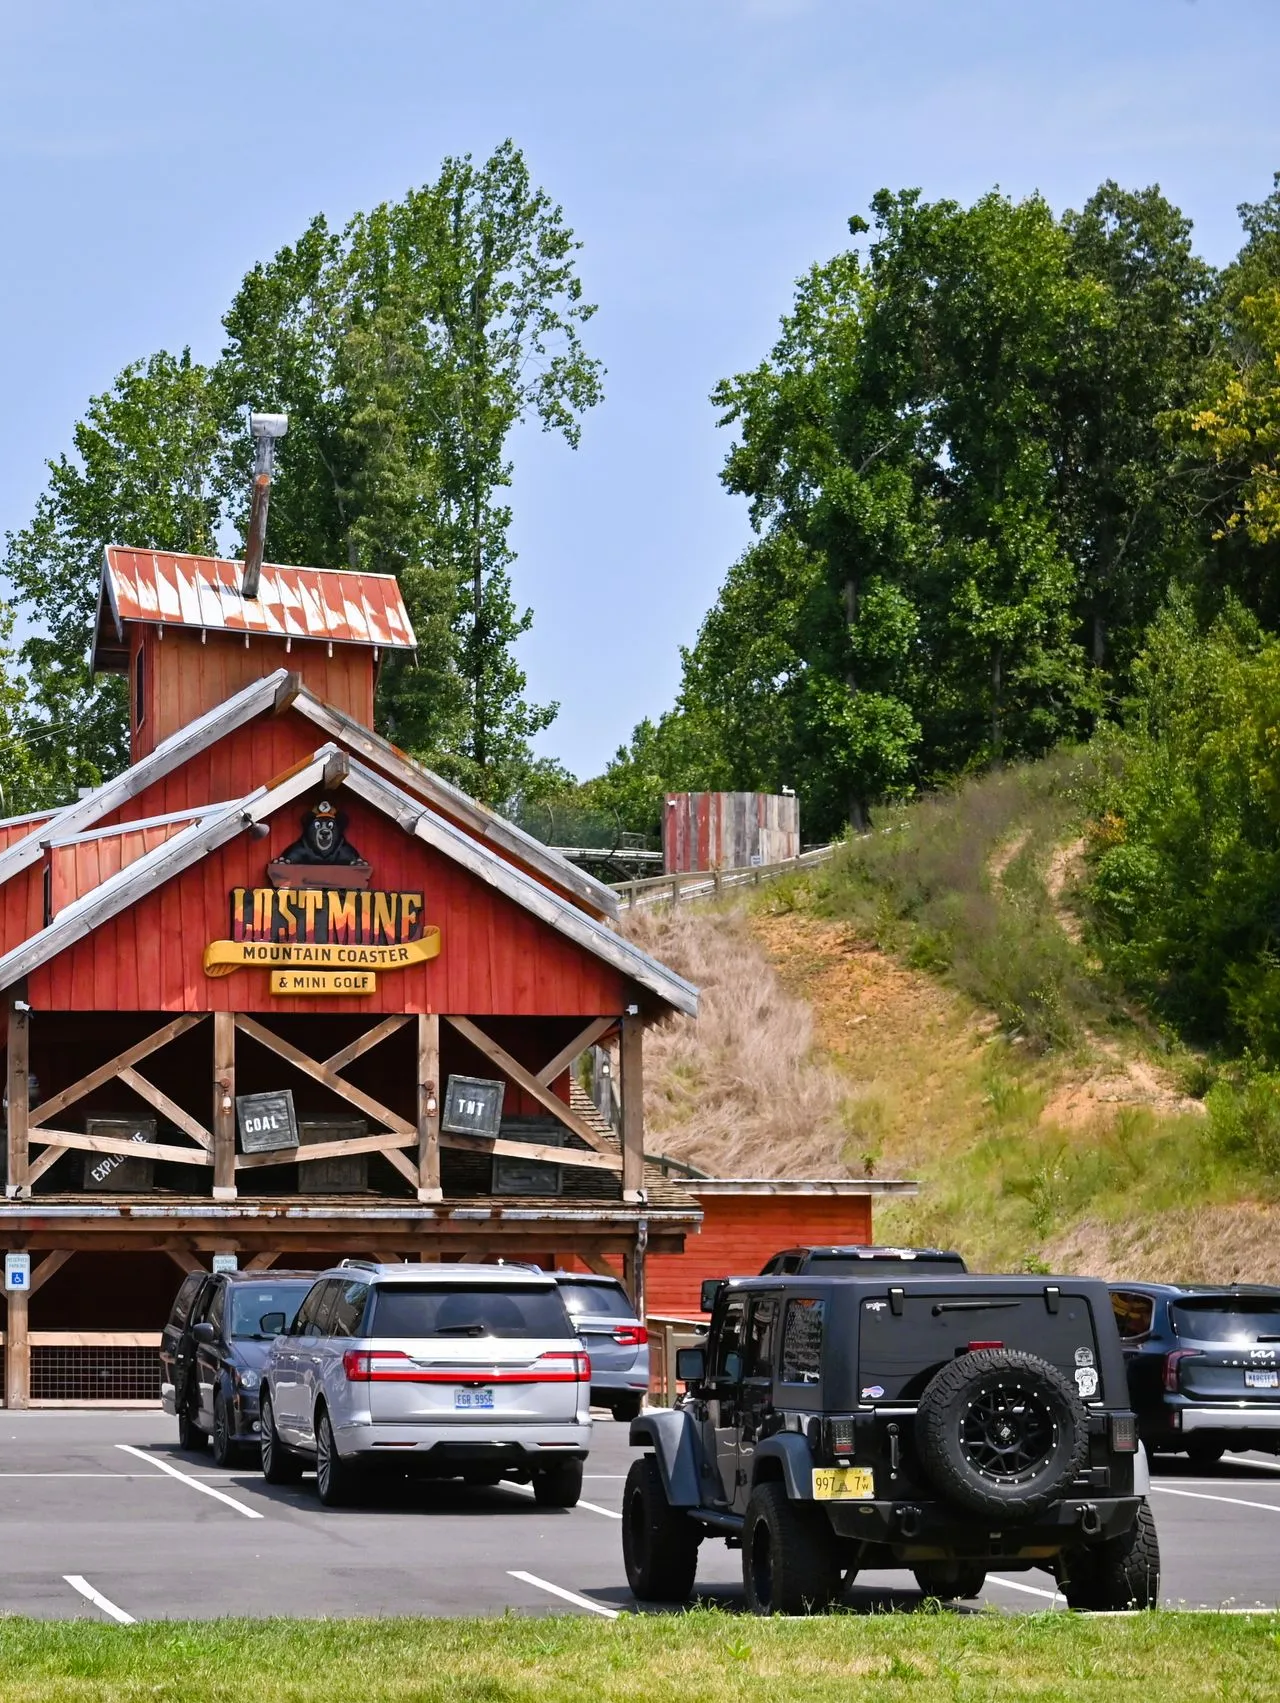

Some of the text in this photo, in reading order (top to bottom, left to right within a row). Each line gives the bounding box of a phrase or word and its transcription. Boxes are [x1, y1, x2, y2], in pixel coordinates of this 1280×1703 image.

[232, 887, 425, 946] LOST MINE
[243, 946, 409, 963] MOUNTAIN COASTER
[278, 976, 369, 988] & MINI GOLF
[457, 1098, 486, 1117] TNT
[245, 1115, 280, 1133] COAL
